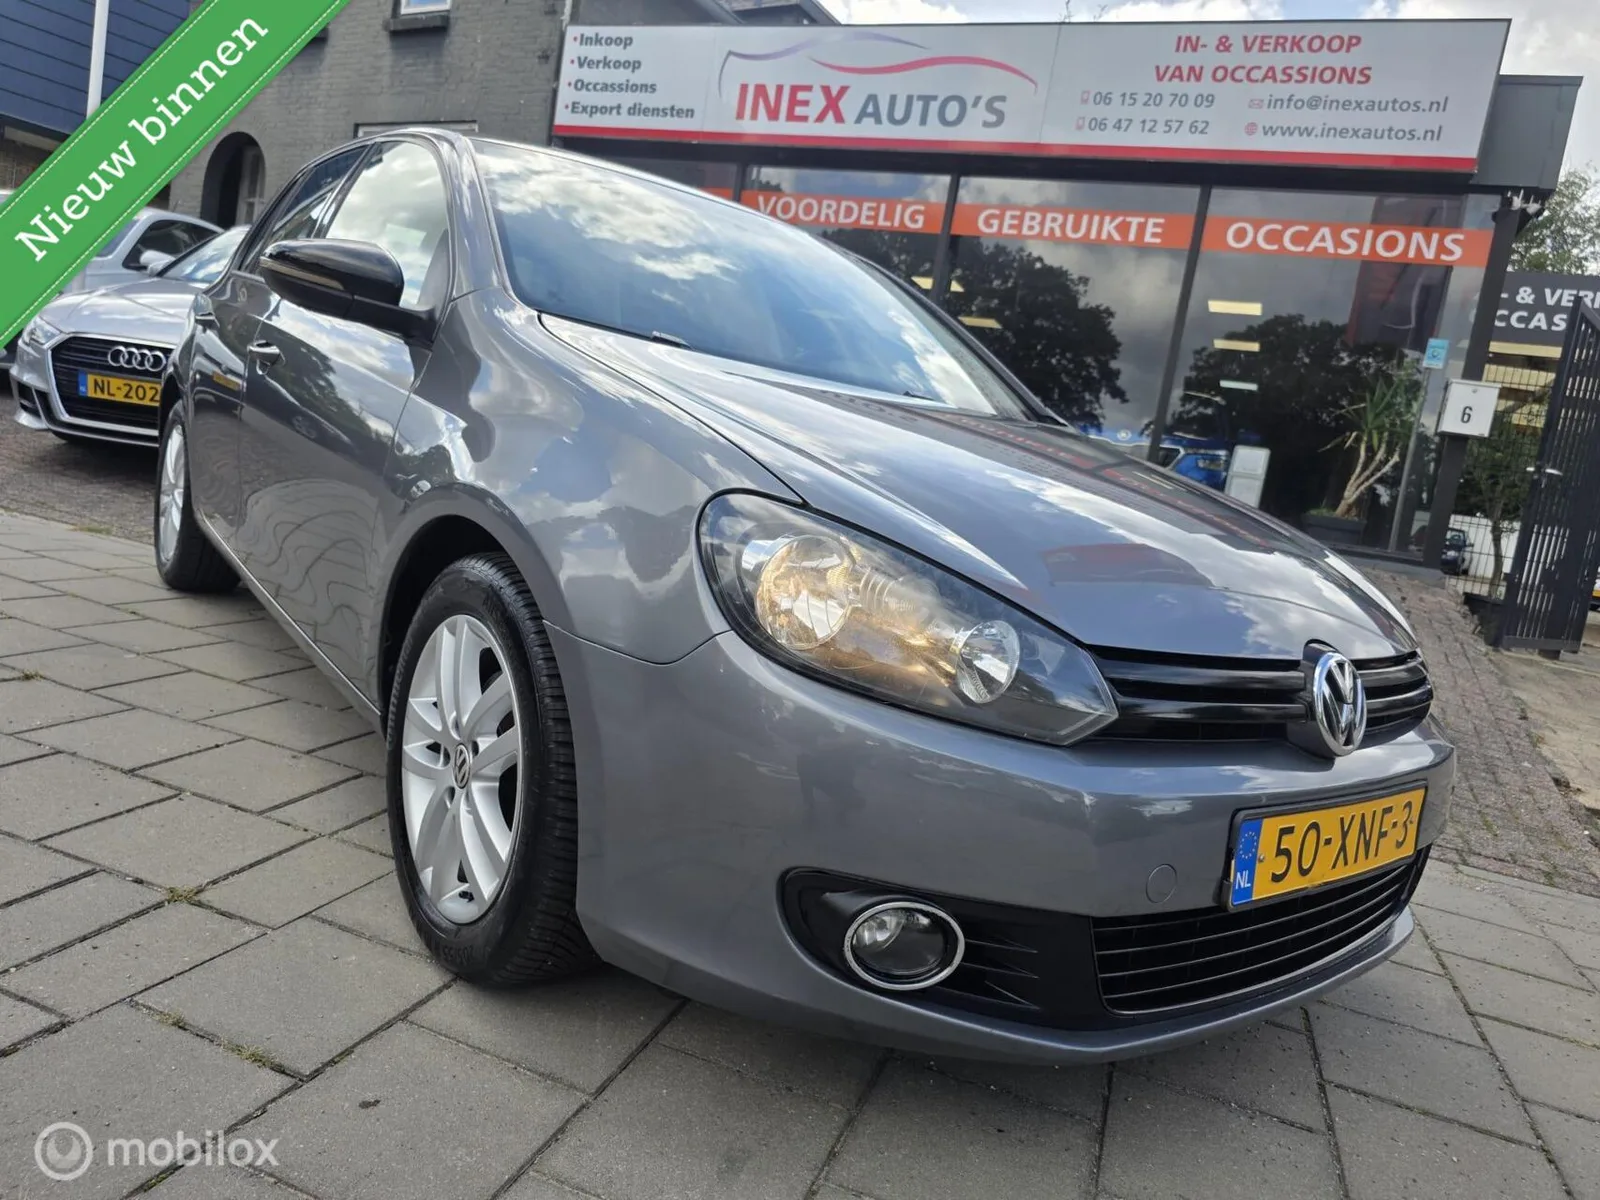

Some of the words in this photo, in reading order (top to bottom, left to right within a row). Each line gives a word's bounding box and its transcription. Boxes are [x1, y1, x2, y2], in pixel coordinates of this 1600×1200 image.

[579, 32, 634, 50] Inkoop
[1174, 35, 1207, 53] IN-
[1215, 35, 1233, 53] &
[1242, 35, 1363, 54] VERKOOP
[577, 56, 642, 73] Verkoop
[1154, 65, 1204, 83] VAN
[1211, 65, 1373, 85] OCCASSIONS
[573, 79, 658, 94] Occassions
[735, 83, 851, 124] INEX
[854, 93, 1008, 129] AUTO'S
[1092, 91, 1113, 106] 06
[1119, 92, 1138, 107] 15
[1142, 92, 1163, 107] 20
[1169, 93, 1189, 108] 70
[1194, 93, 1216, 108] 09
[1266, 94, 1449, 113] info@inexautos.nl
[570, 101, 622, 118] Export
[627, 102, 695, 119] diensten
[1087, 117, 1108, 132] 06
[1113, 117, 1133, 133] 47
[1140, 119, 1158, 133] 12
[1163, 119, 1184, 134] 57
[1189, 120, 1210, 135] 62
[1261, 122, 1443, 142] www.inexautos.nl
[757, 195, 926, 229] VOORDELIG
[977, 208, 1166, 244] GEBRUIKTE
[1226, 221, 1466, 262] OCCASIONS
[1515, 286, 1536, 305] &
[93, 378, 160, 403] NL-202
[1460, 405, 1473, 424] 6
[1270, 800, 1414, 884] 50-XNF-3
[1235, 871, 1252, 890] NL
